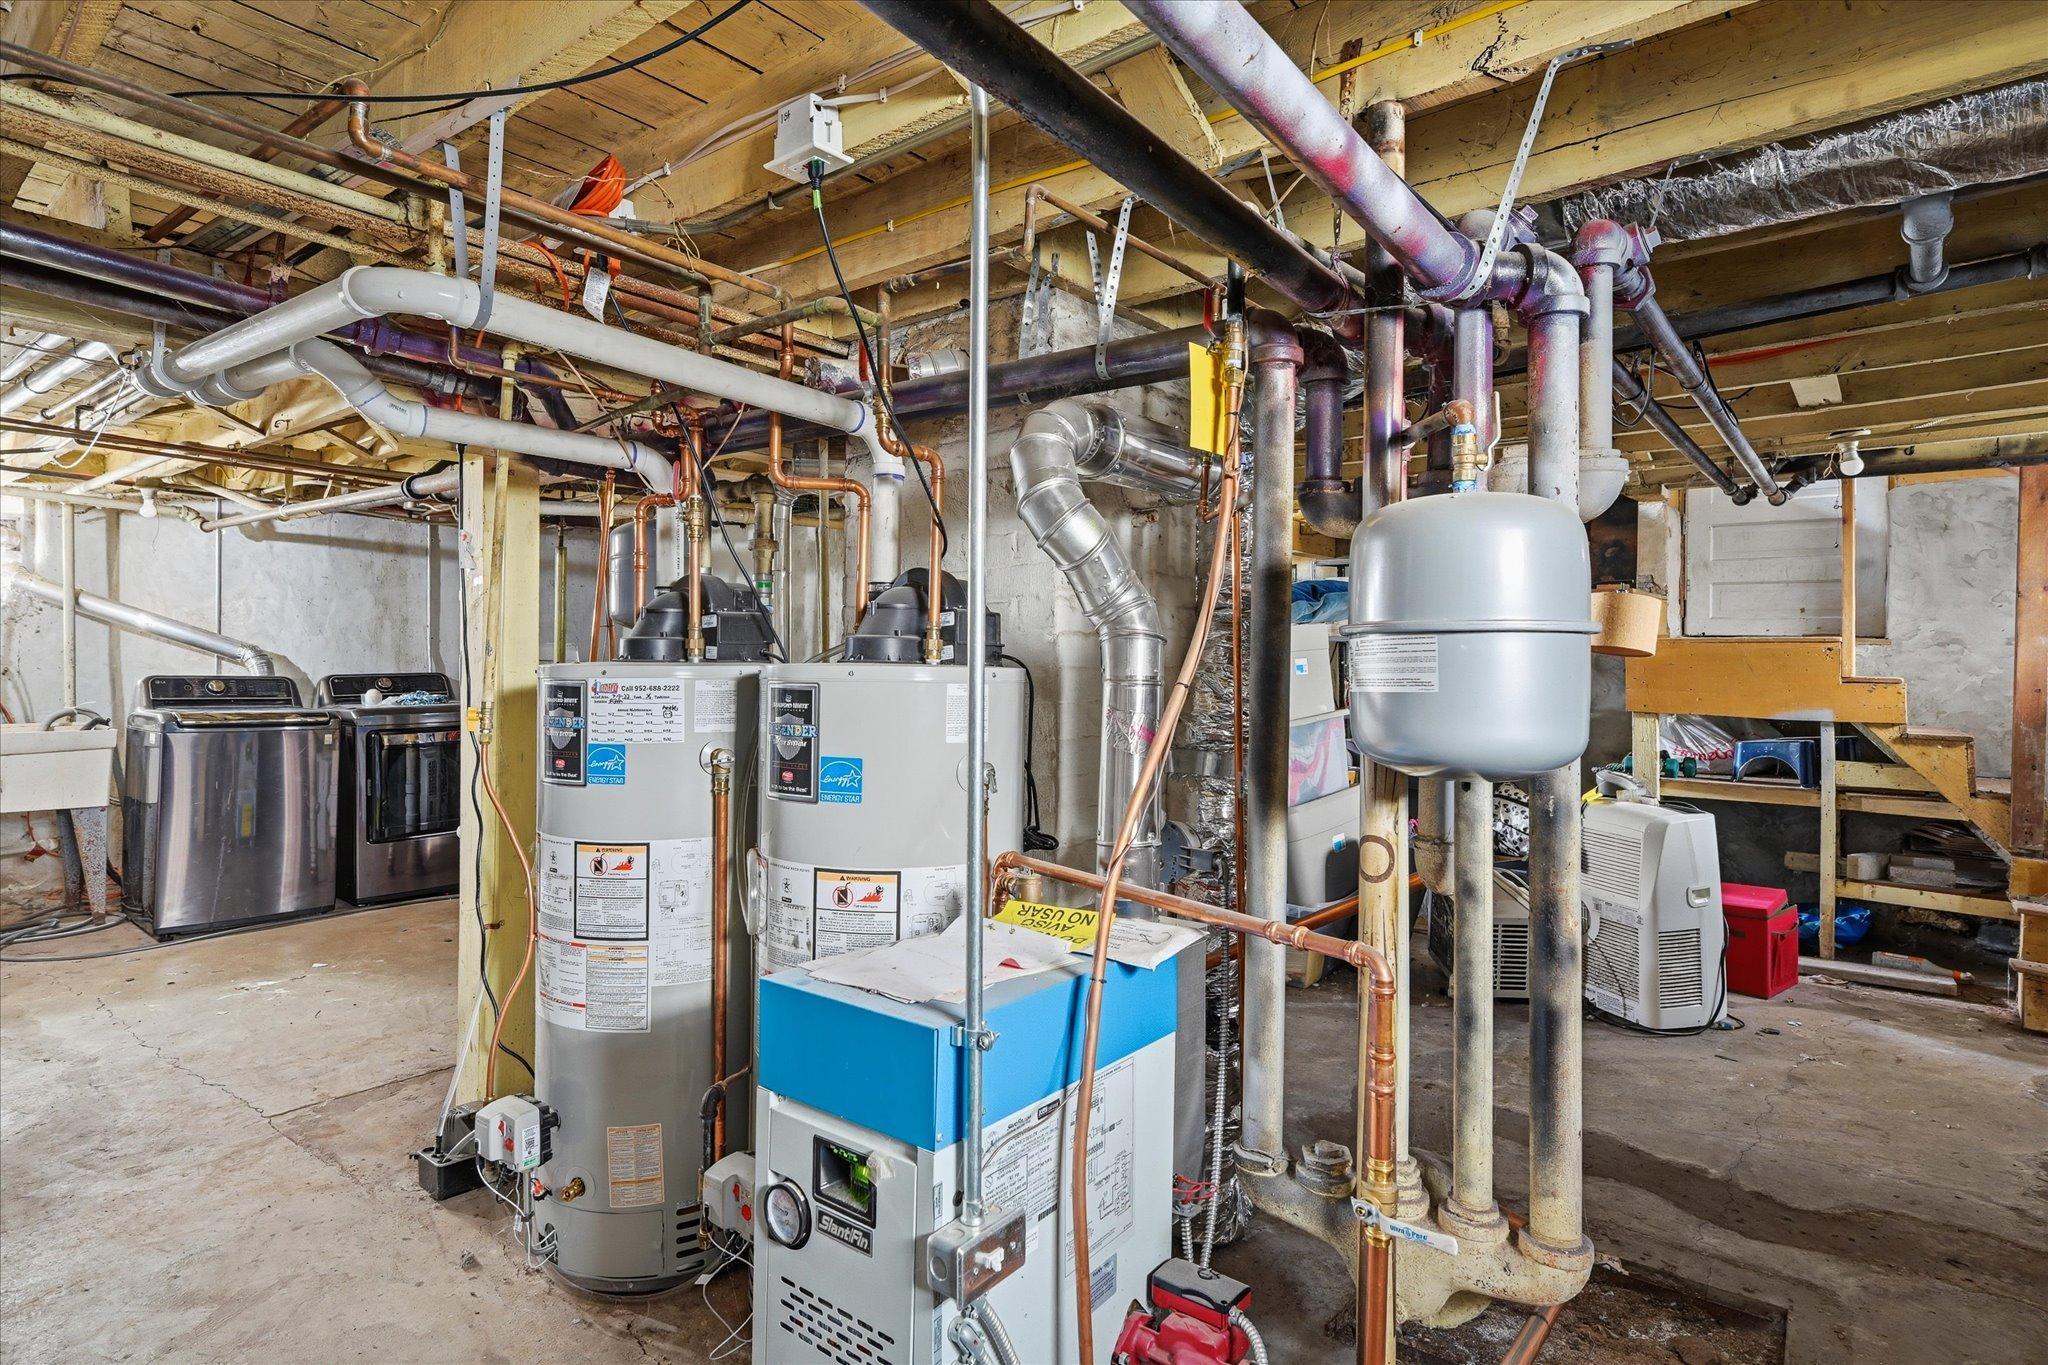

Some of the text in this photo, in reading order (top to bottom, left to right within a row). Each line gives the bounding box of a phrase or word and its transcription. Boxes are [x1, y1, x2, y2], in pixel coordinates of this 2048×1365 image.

[588, 776, 610, 784] ENERGY
[821, 793, 860, 803] ENERGY STAR
[1017, 904, 1096, 926] NO USAR
